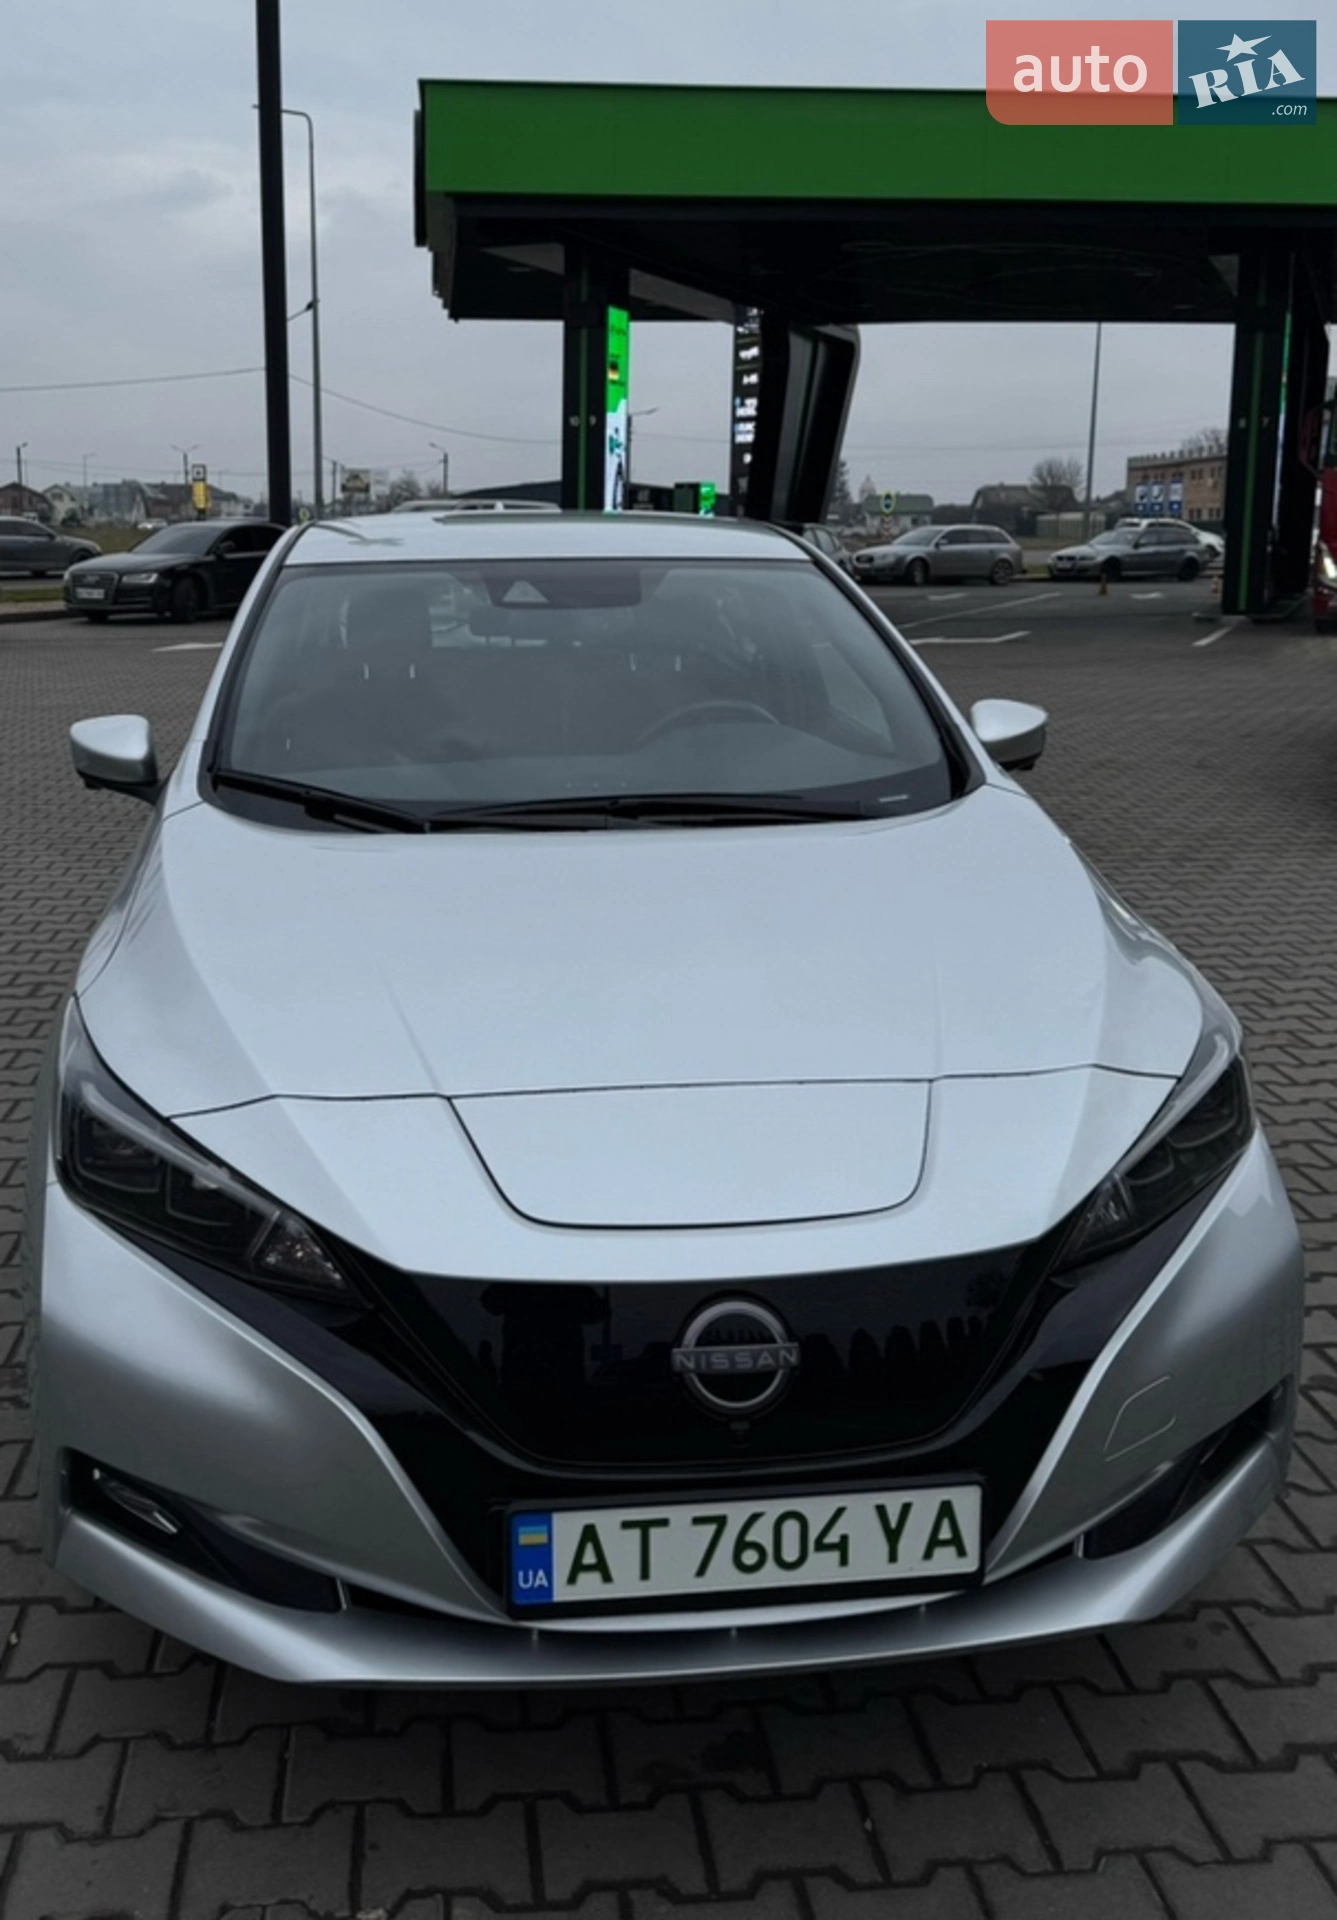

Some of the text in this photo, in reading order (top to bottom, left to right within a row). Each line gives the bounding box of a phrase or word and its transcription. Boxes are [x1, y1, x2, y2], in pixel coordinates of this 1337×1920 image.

[675, 1348, 798, 1370] NISSAN
[566, 1499, 968, 1585] AT 7604 YA
[518, 1569, 549, 1589] UA
